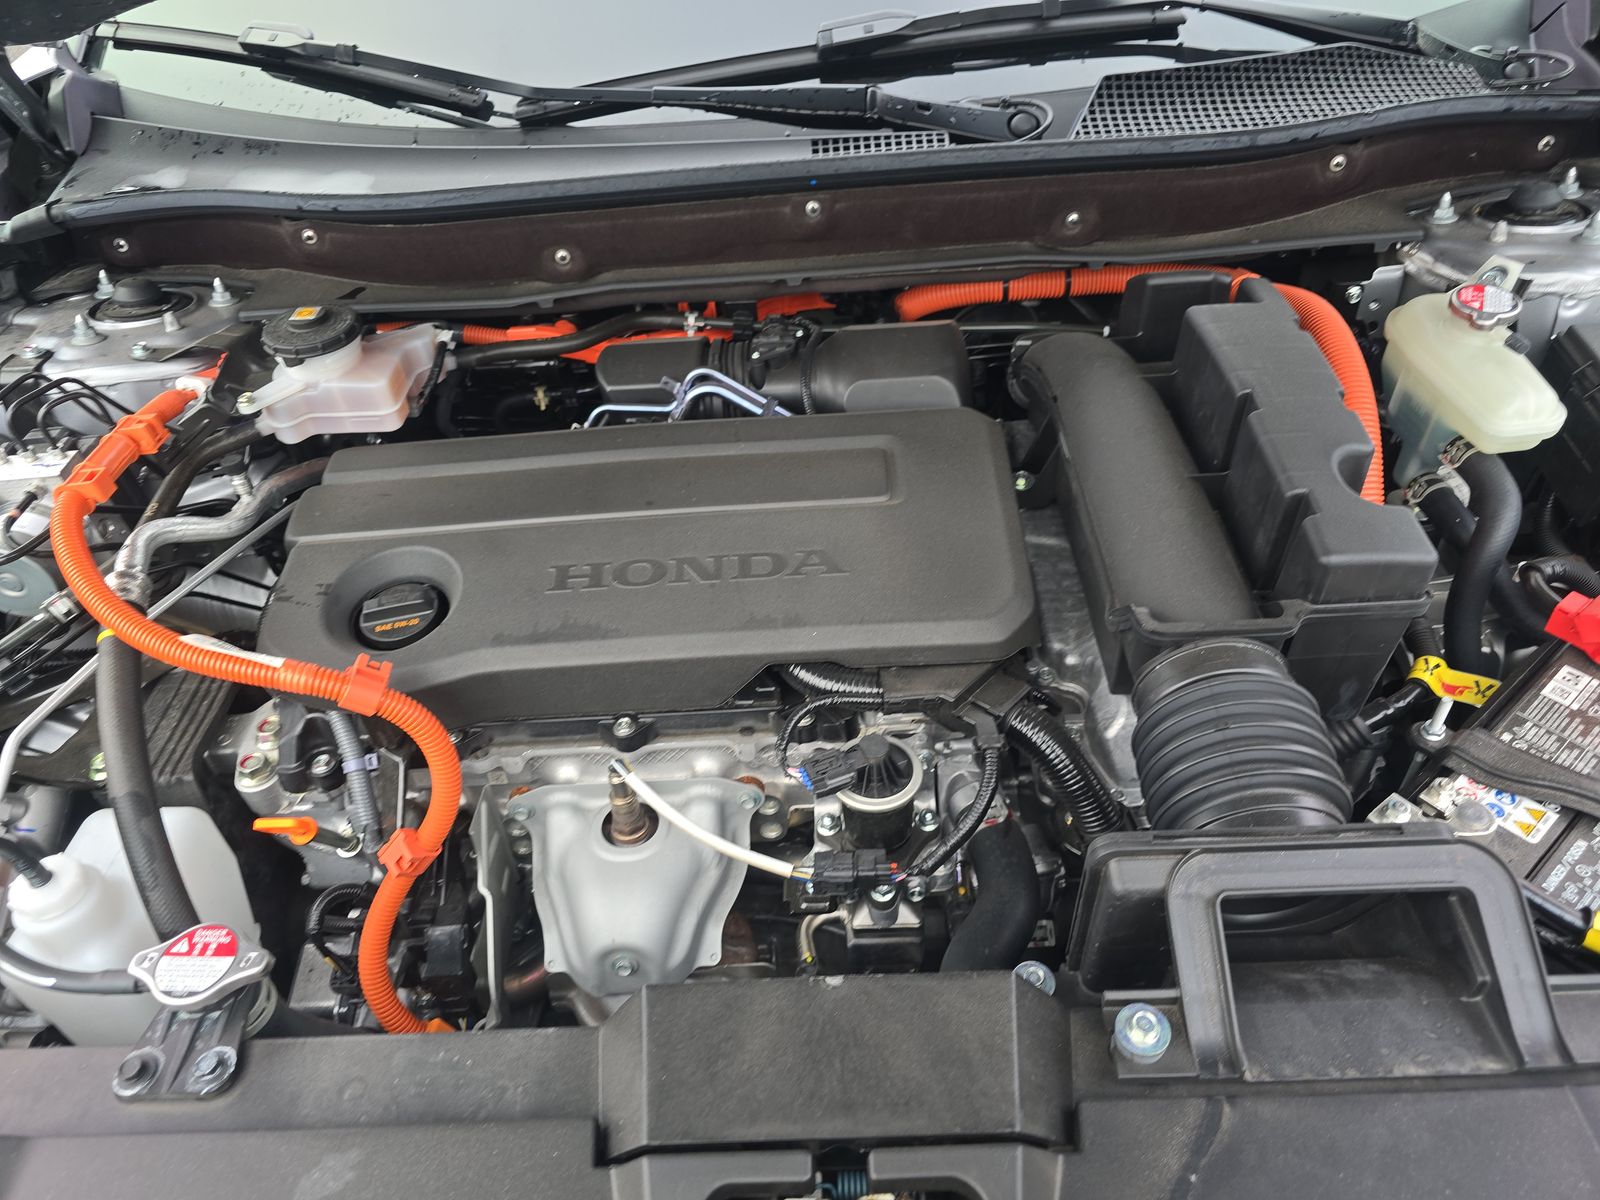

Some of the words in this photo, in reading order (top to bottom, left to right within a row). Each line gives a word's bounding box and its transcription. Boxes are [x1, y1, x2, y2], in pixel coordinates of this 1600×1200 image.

[544, 549, 850, 594] HONDA
[374, 623, 393, 632] SAE
[393, 617, 420, 628] 0W-20
[196, 928, 229, 936] DANGER
[192, 935, 231, 944] WARNING
